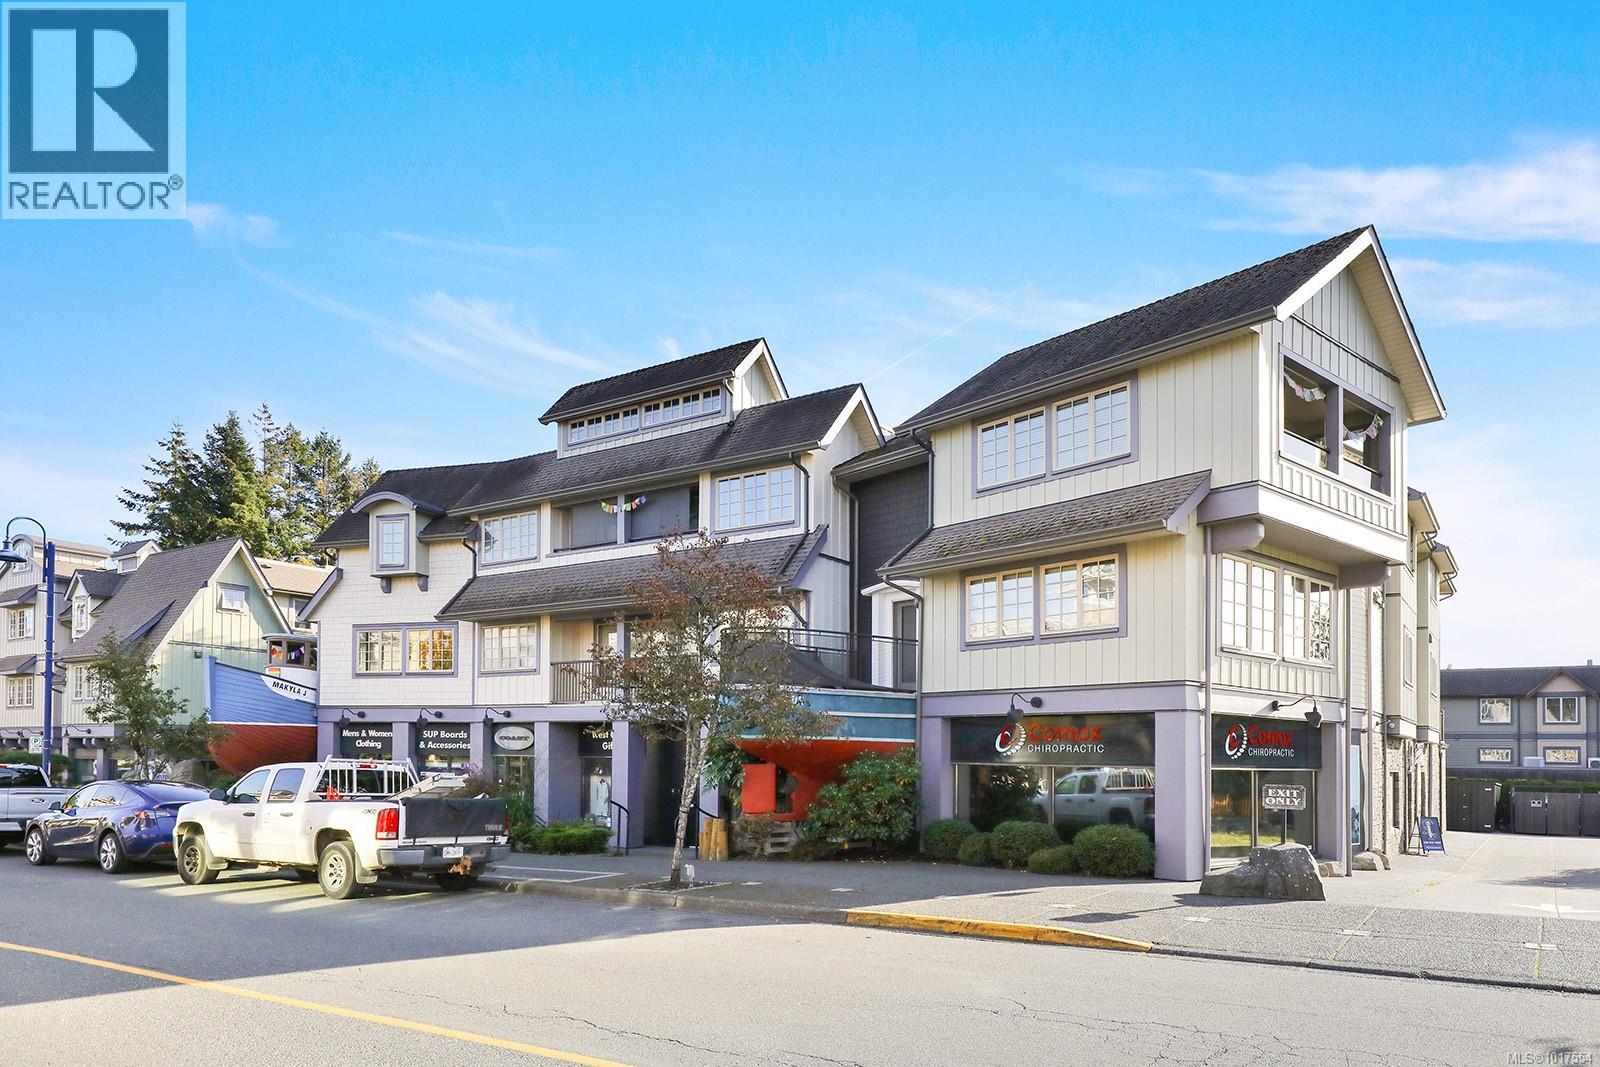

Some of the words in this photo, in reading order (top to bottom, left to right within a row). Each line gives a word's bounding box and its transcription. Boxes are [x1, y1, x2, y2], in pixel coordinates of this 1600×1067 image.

[272, 681, 301, 694] MAKYLA
[422, 730, 439, 738] SUP
[440, 730, 468, 739] Boards
[1027, 722, 1104, 743] Comox
[1248, 725, 1293, 746] Comox
[355, 740, 381, 749] Clothing
[419, 741, 426, 749] &
[427, 741, 471, 749] Accessories
[1027, 744, 1105, 753] CHIROPRACTIC
[1248, 747, 1295, 757] CHIROPRACTIC
[1268, 788, 1300, 798] EXIT
[1265, 797, 1301, 806] ONLY
